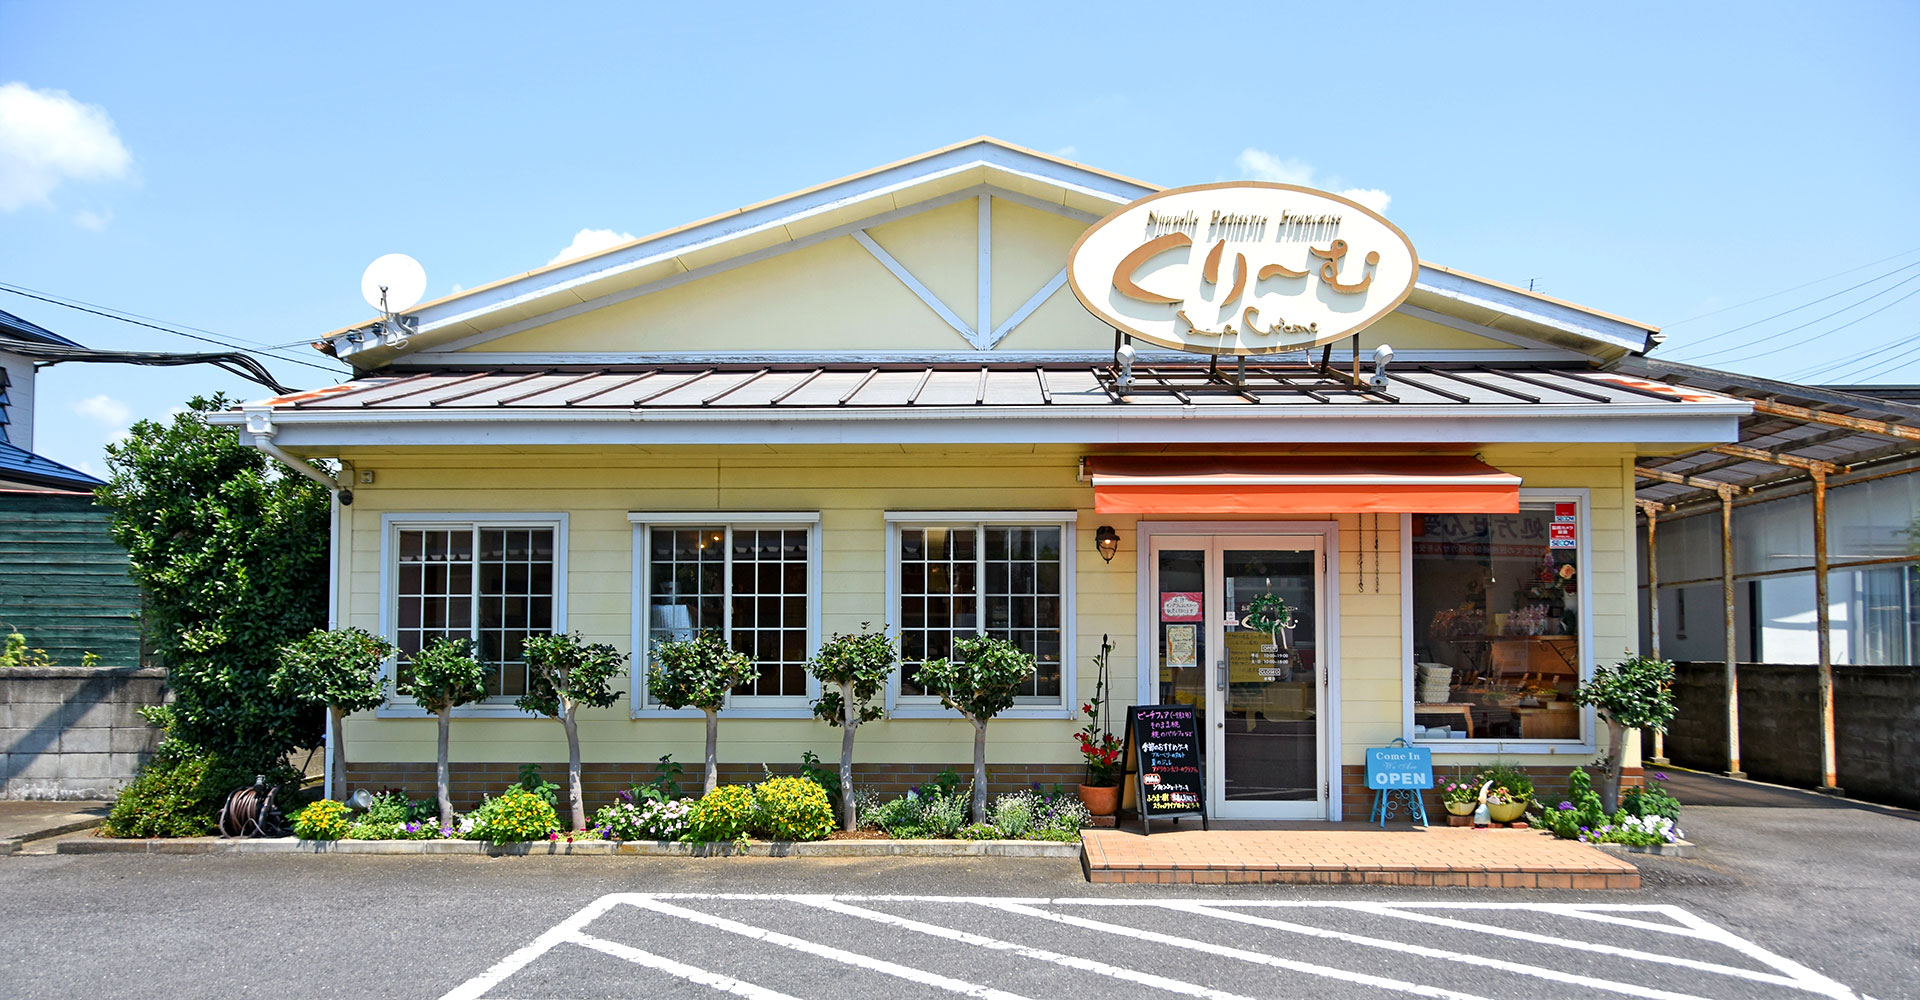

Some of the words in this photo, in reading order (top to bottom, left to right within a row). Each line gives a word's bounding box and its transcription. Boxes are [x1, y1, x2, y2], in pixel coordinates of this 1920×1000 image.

[1112, 232, 1380, 308] くりーむ
[1376, 752, 1406, 761] Come
[1408, 752, 1420, 761] In
[1375, 773, 1426, 785] OPEN
